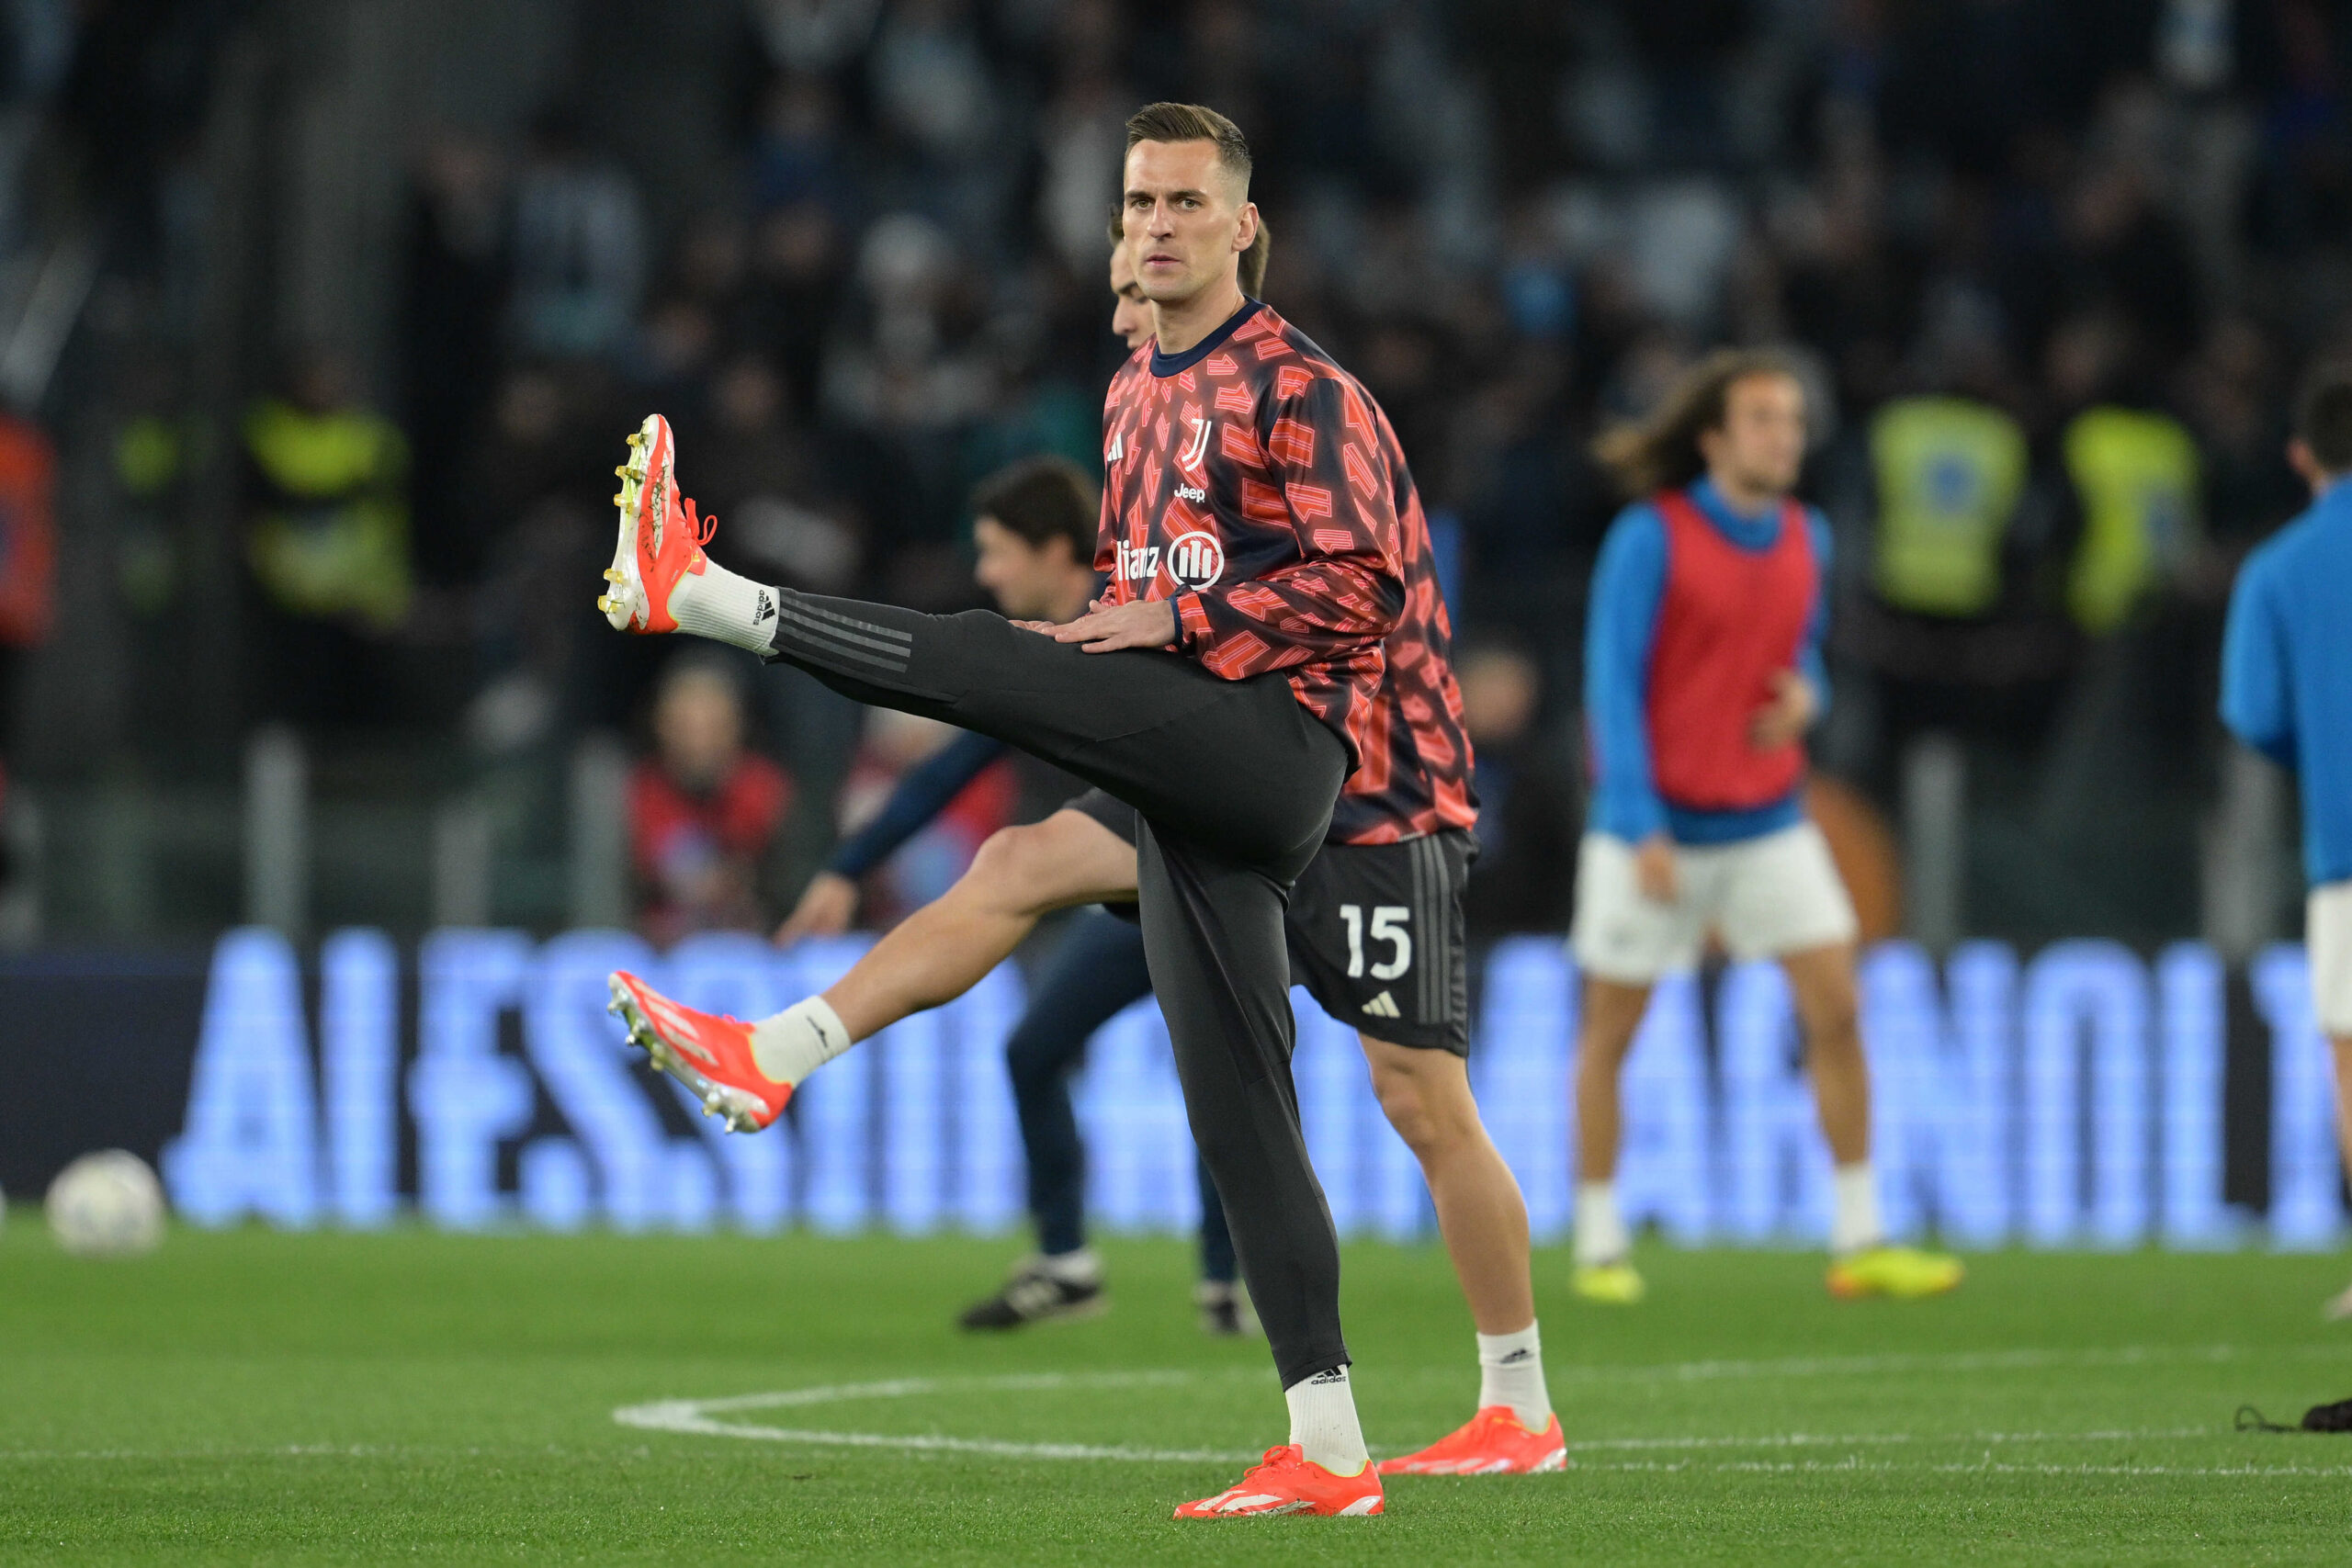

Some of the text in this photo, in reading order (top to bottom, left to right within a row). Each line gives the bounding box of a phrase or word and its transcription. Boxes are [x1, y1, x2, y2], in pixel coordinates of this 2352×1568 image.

[1173, 482, 1205, 503] Jeep
[1116, 540, 1159, 581] lianz
[752, 589, 766, 626] adidas
[1339, 903, 1412, 981] 15
[1310, 1375, 1347, 1385] adidas
